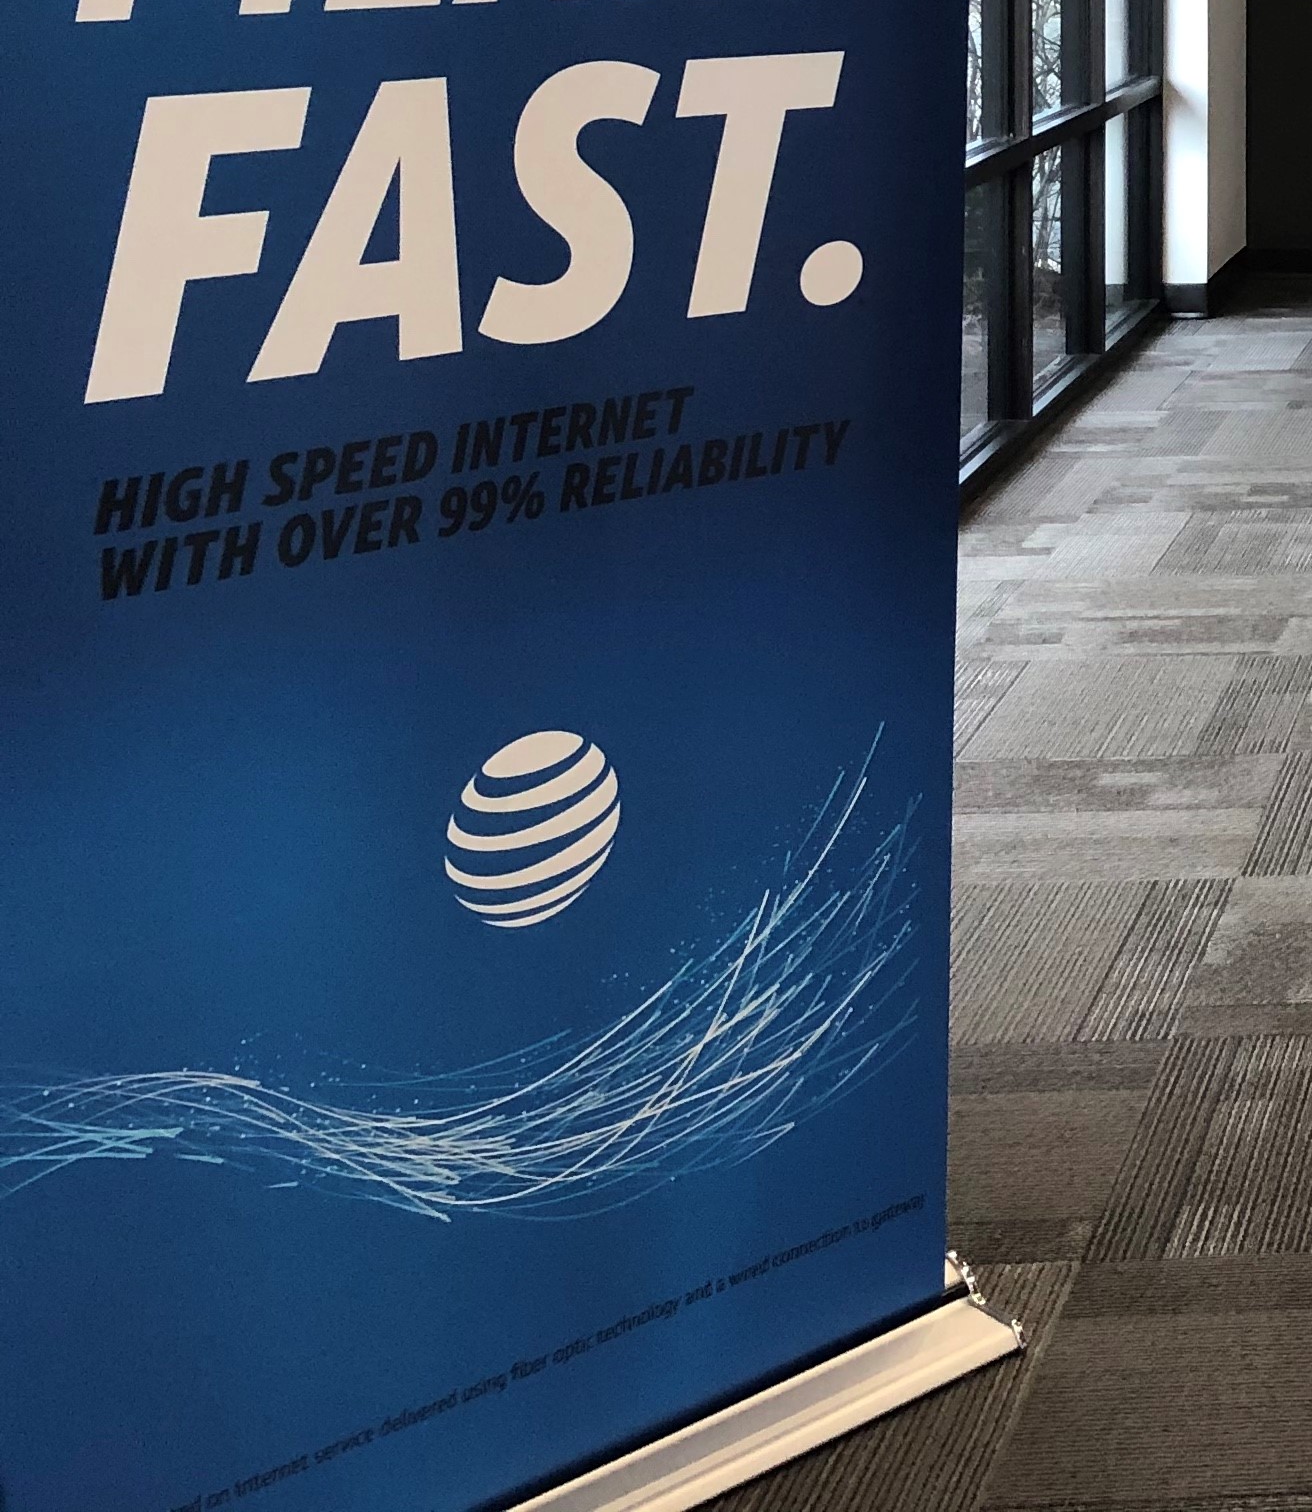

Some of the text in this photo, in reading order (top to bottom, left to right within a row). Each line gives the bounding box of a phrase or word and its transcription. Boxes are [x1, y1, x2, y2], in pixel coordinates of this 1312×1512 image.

[83, 51, 866, 405] FAST.
[93, 386, 695, 535] HIGH SPEED INTERNET
[101, 419, 852, 602] WITH OVER 99% RELIABILITY
[314, 1428, 375, 1465] service
[379, 1388, 459, 1437] delivered
[460, 1372, 508, 1403] using
[510, 1353, 549, 1381] fiber
[596, 1294, 683, 1346] technology
[684, 1279, 713, 1307] and
[771, 1224, 852, 1269] connection
